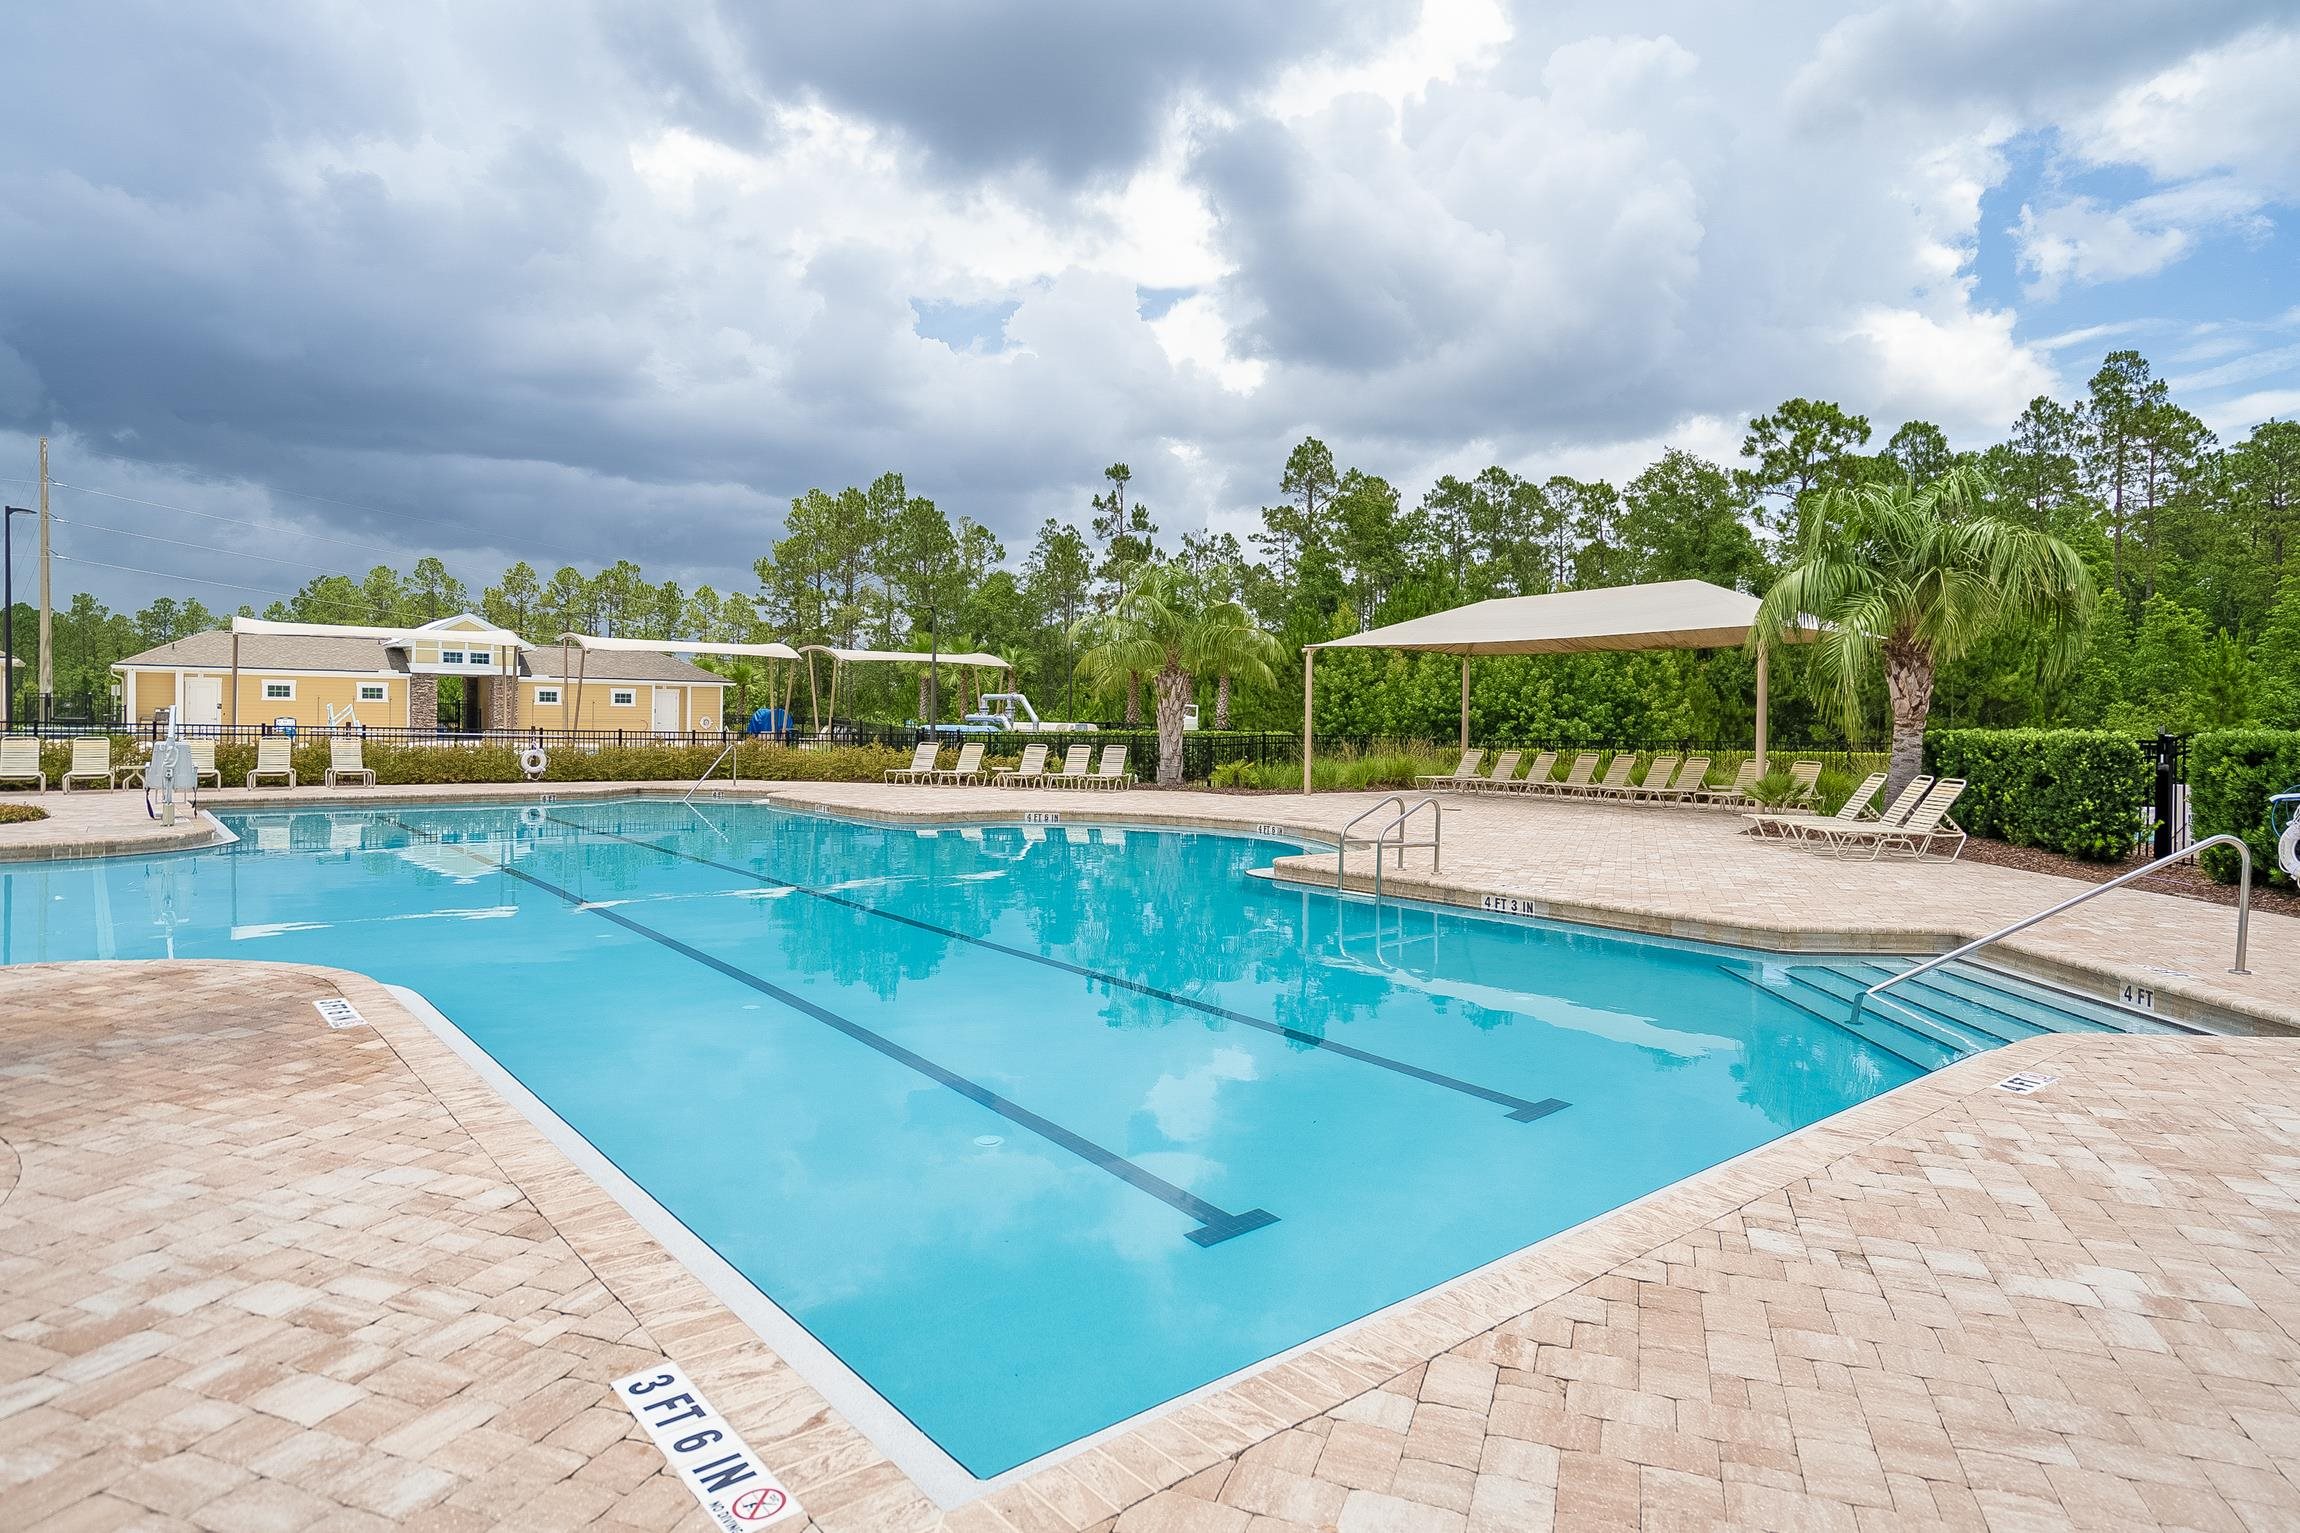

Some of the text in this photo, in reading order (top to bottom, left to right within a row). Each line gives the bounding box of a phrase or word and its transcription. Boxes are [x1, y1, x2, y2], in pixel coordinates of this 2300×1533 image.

[1034, 813, 1042, 822] FT
[1051, 814, 1059, 823] IN
[1484, 896, 1534, 913] 4 FT 3 IN
[2124, 985, 2154, 1008] 4 FT
[2007, 1077, 2041, 1088] FT
[628, 1374, 758, 1493] 3 FT 6 IN
[709, 1501, 725, 1512] NO
